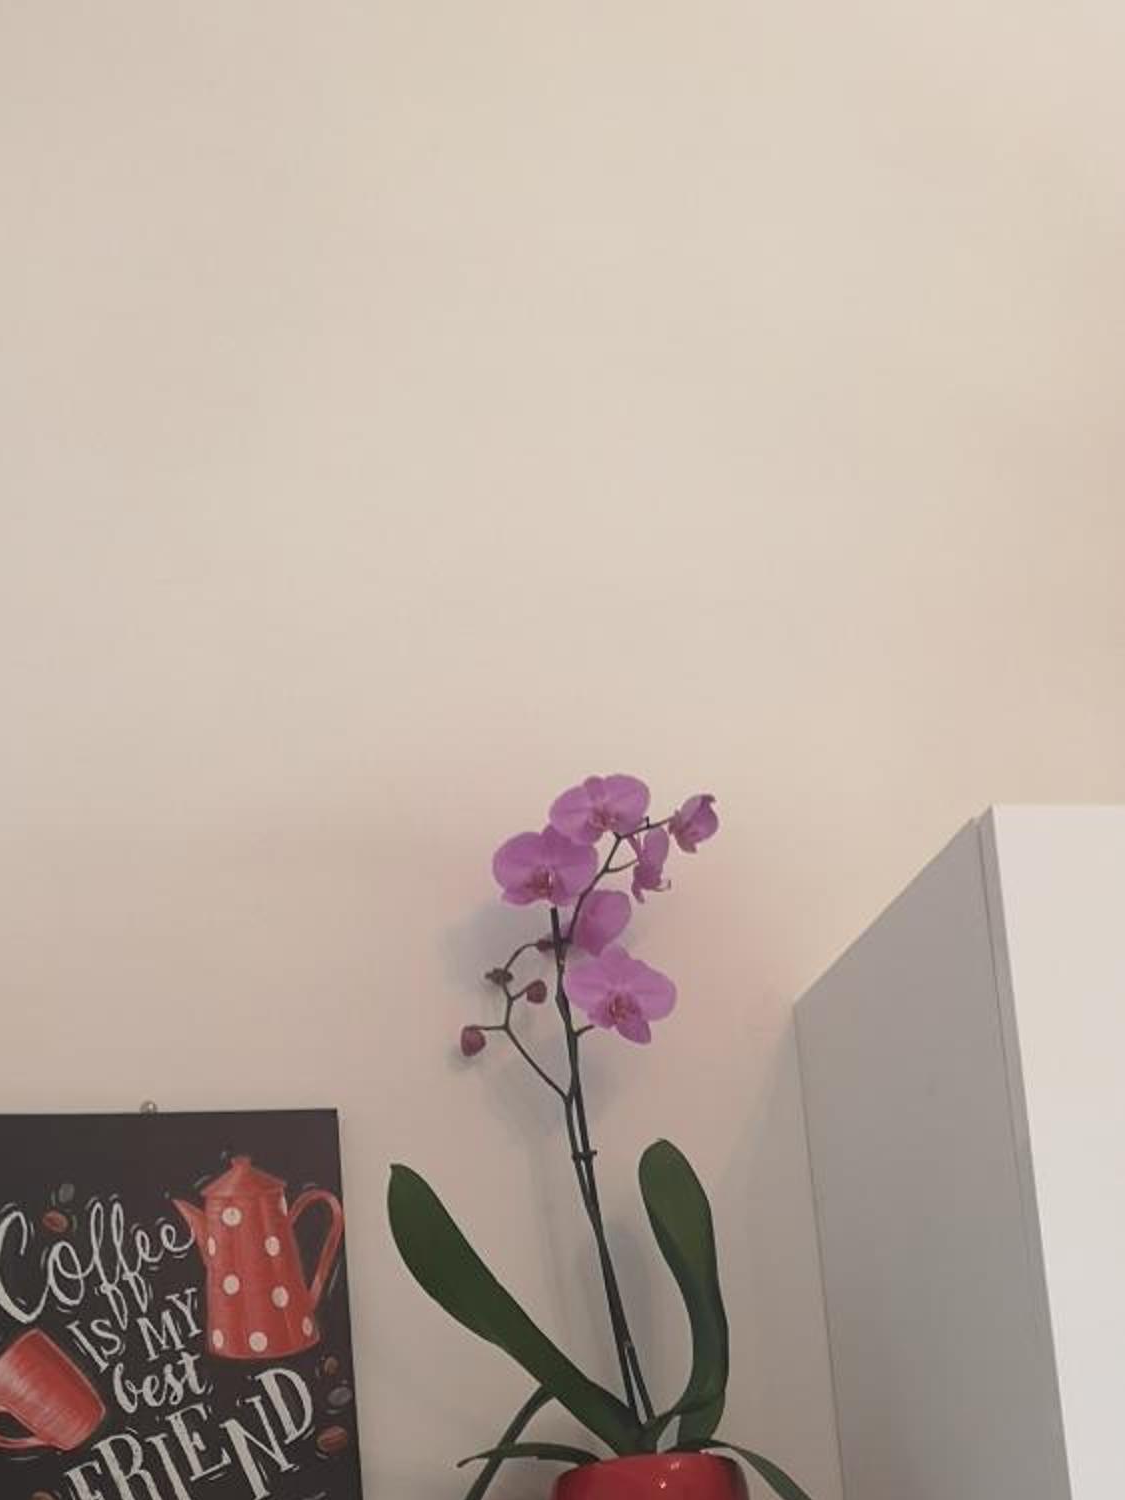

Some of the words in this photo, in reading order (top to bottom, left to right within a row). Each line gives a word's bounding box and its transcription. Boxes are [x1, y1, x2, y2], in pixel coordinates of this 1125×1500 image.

[67, 1316, 125, 1374] IS
[137, 1287, 202, 1362] MY
[113, 1350, 207, 1414] best
